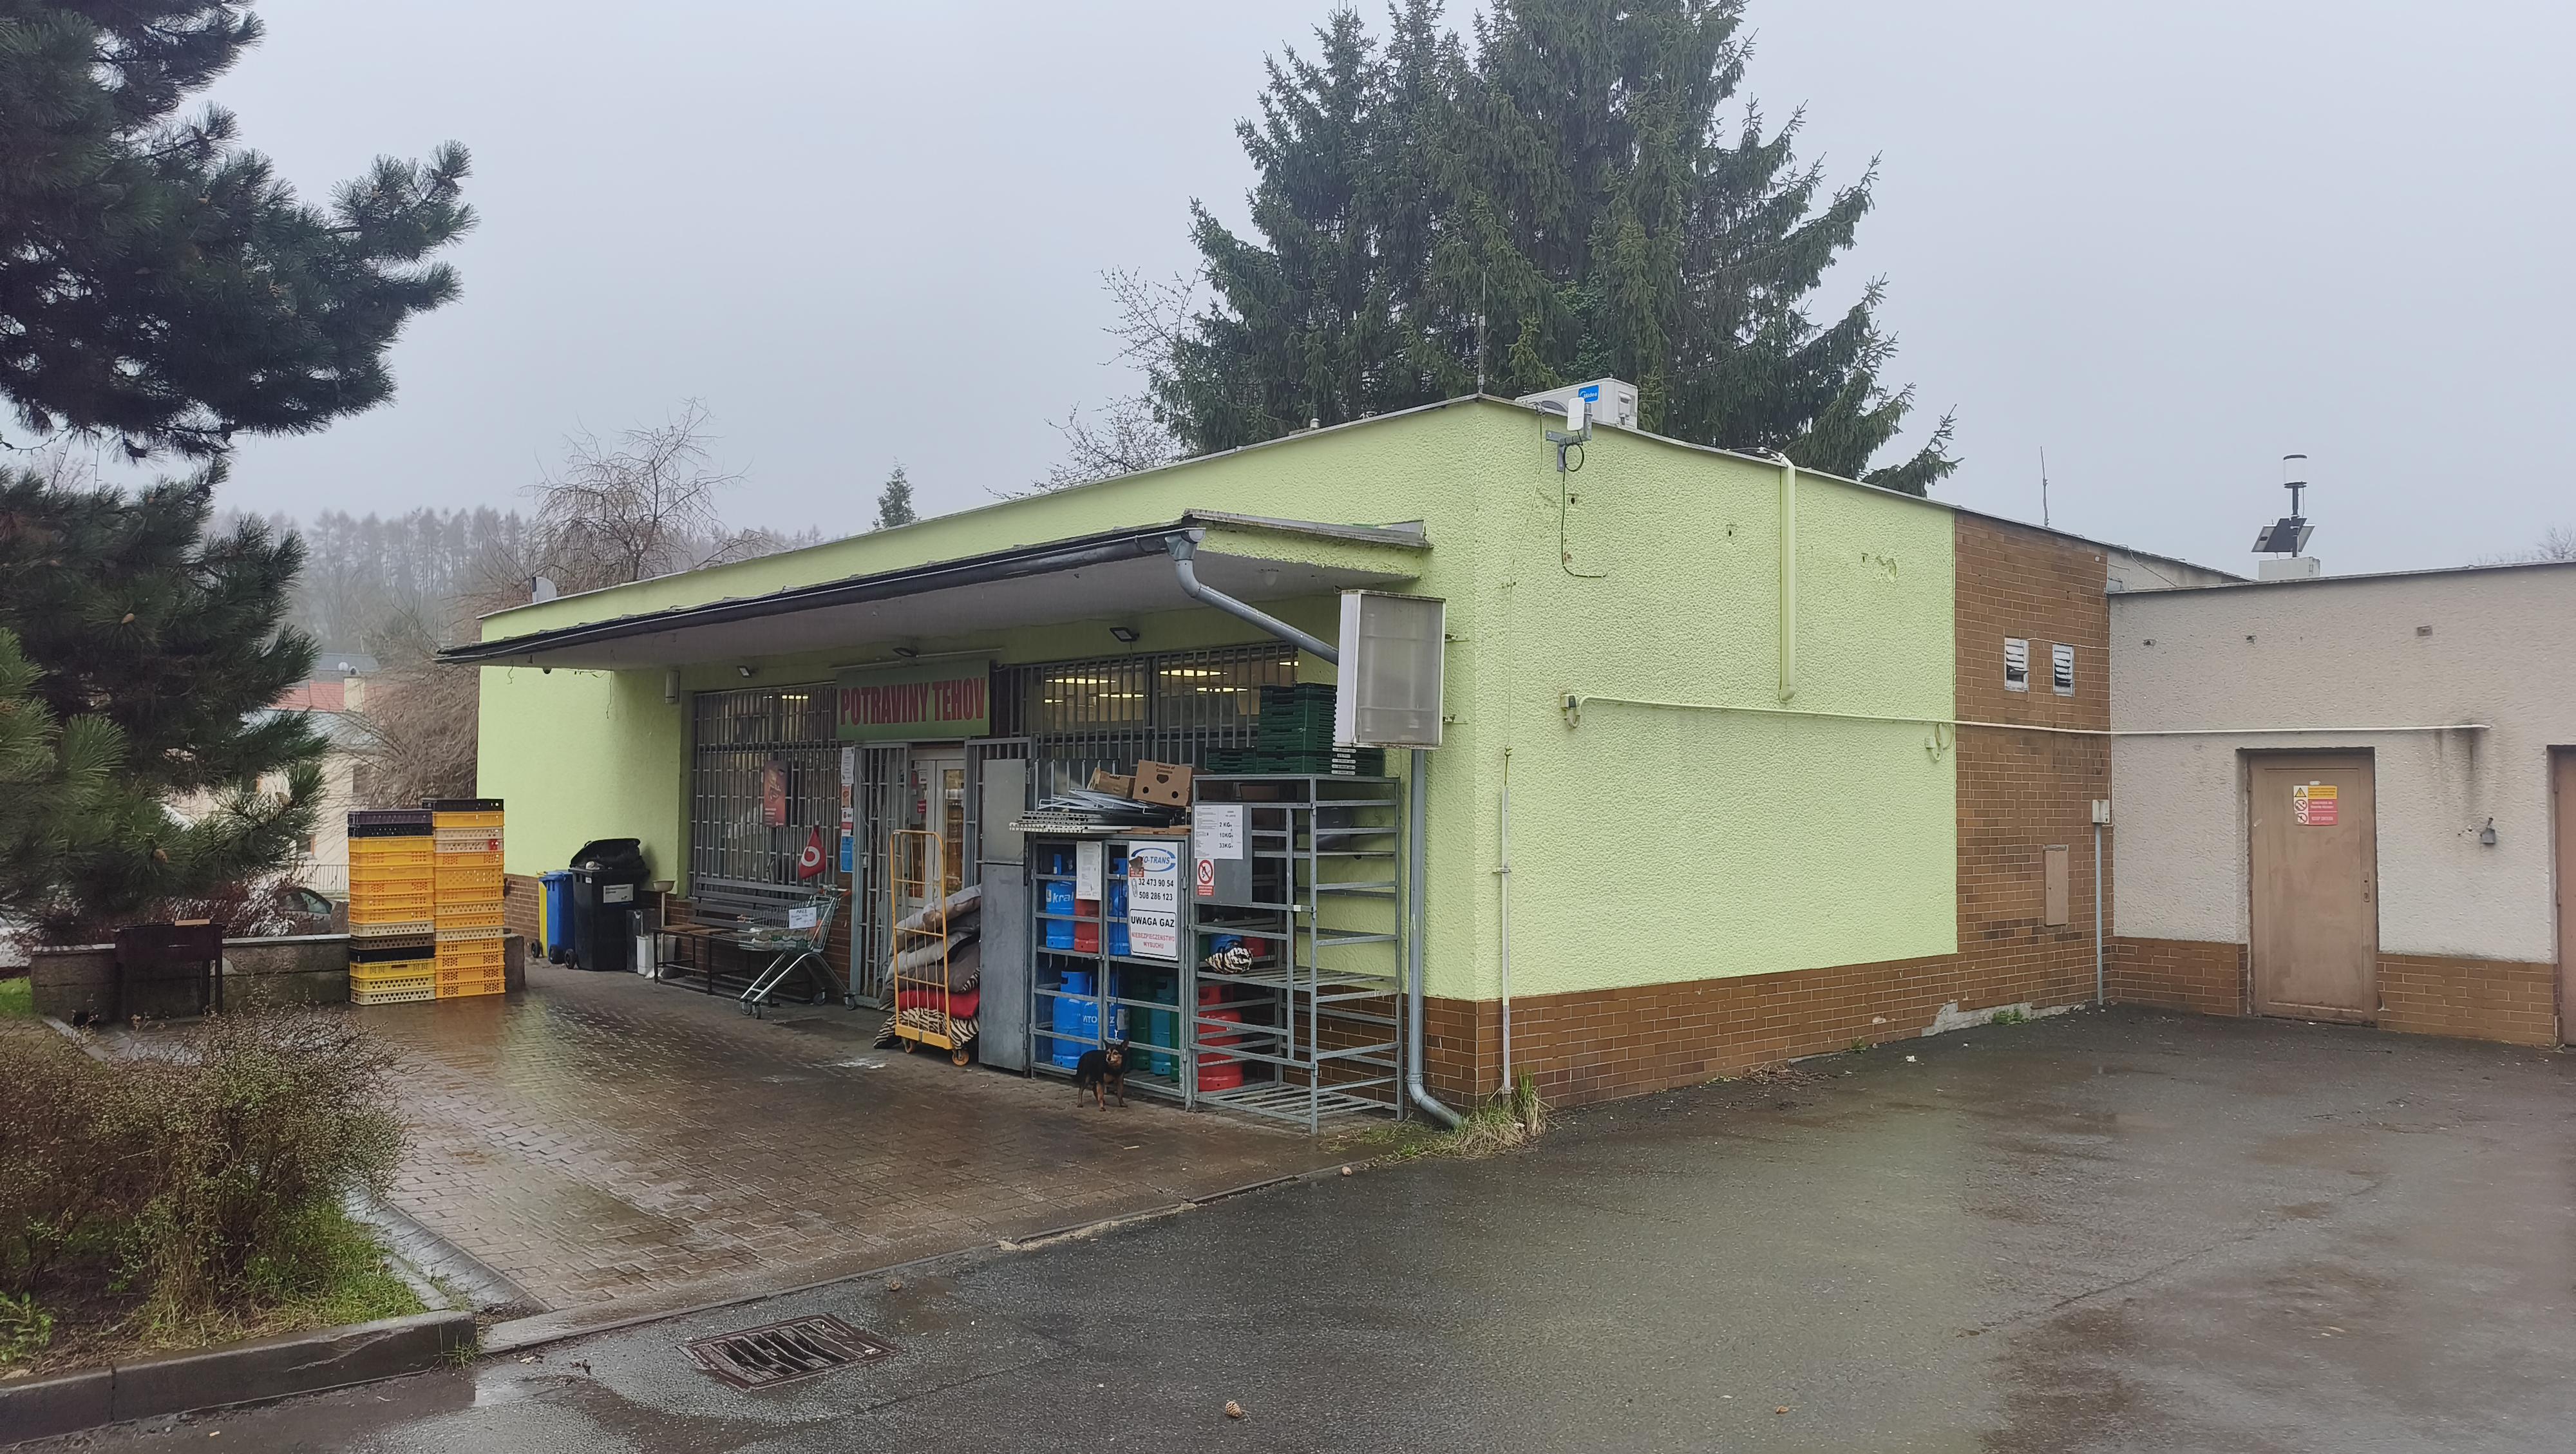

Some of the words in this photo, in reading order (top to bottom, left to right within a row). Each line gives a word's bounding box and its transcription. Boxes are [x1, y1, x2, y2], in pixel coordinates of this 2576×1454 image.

[840, 682, 929, 725] POTRAVINY
[933, 677, 986, 721] TEHOV
[1142, 856, 1170, 864] O-TRANS
[1151, 892, 1160, 900] 286
[1131, 916, 1157, 926] UWAGA
[1159, 919, 1175, 927] GAZ
